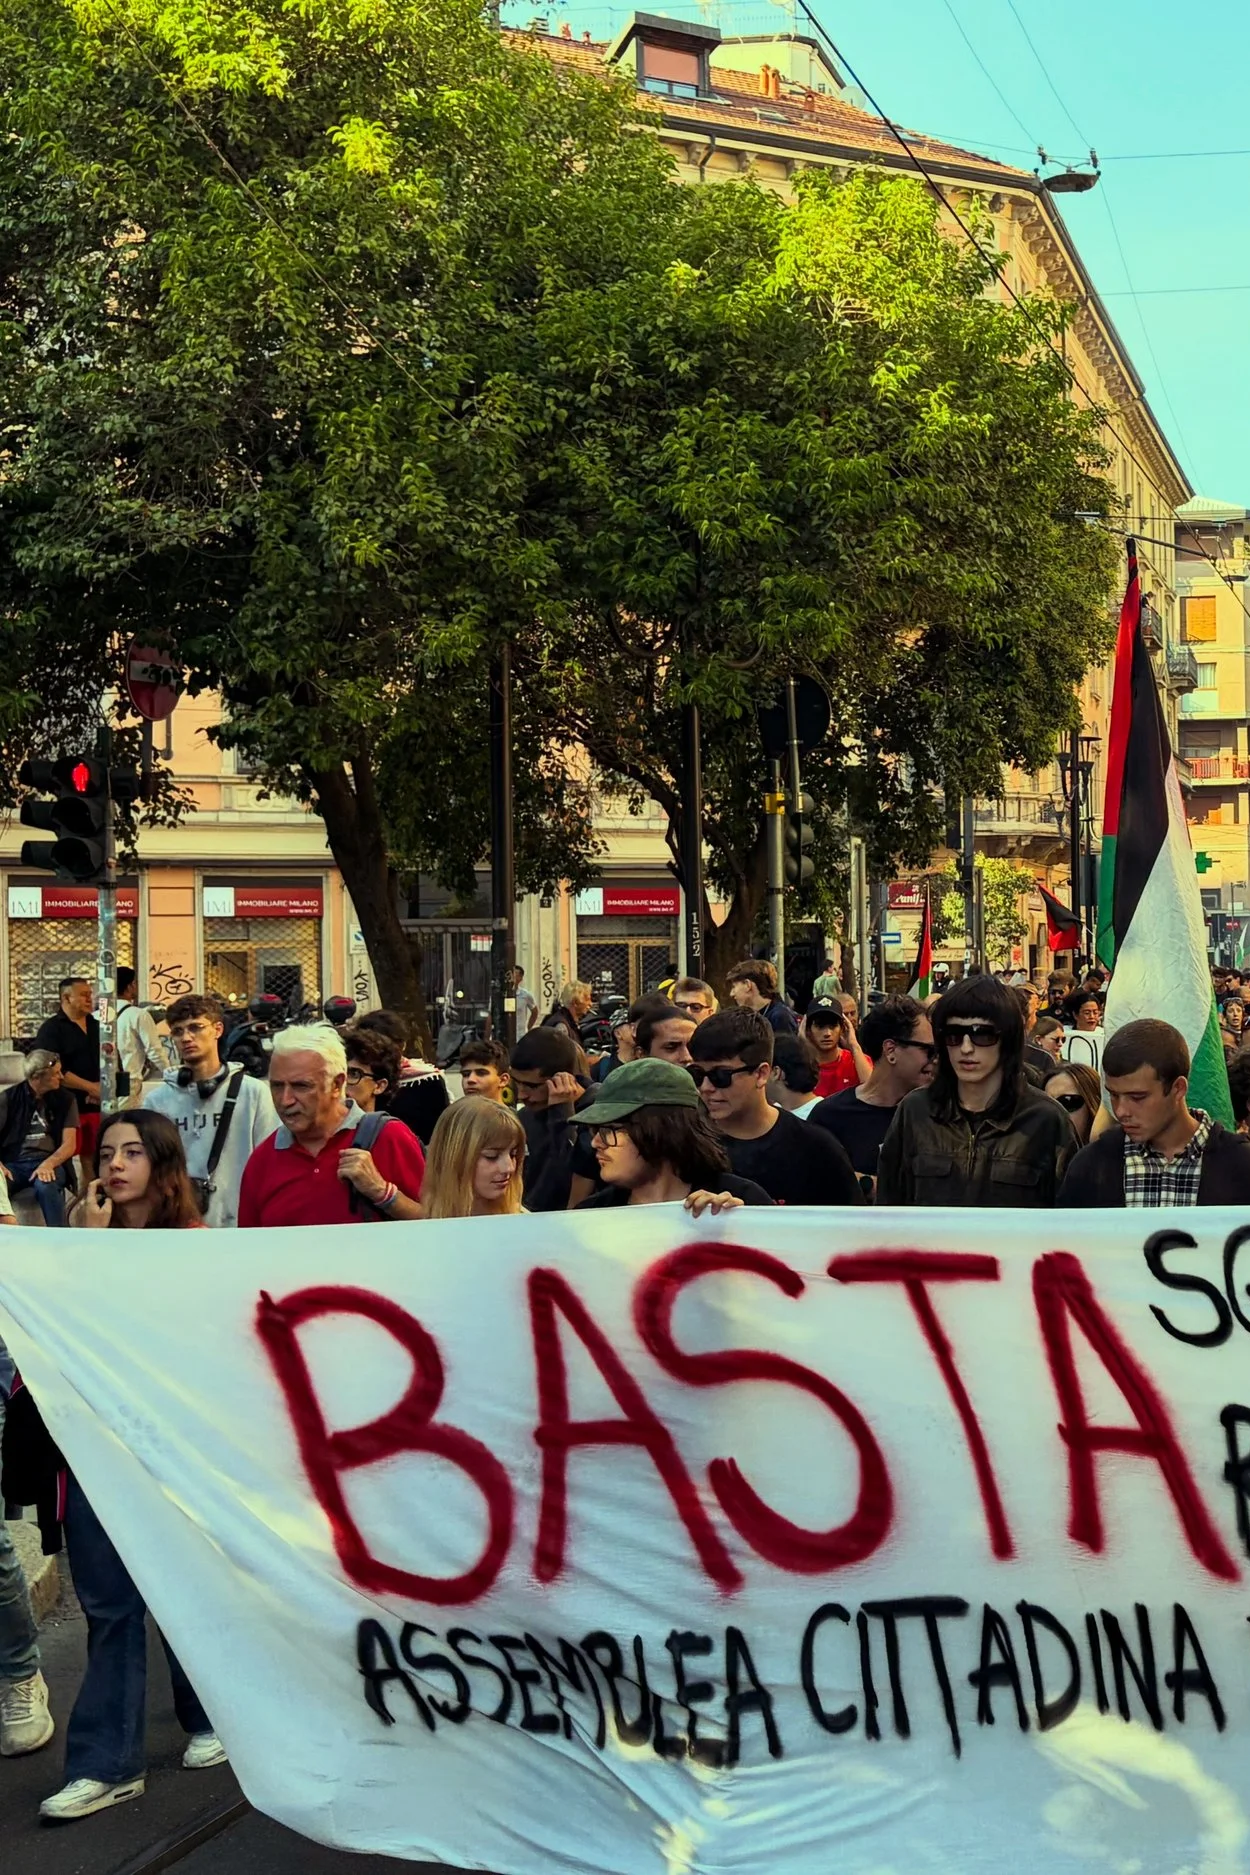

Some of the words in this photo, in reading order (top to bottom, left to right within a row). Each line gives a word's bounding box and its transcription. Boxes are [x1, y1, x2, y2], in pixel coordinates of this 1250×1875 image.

[11, 901, 39, 914] IMI
[206, 900, 232, 914] IMI
[579, 900, 601, 913] IMI
[255, 1241, 1242, 1605] BASTA
[356, 1617, 783, 1768] ASSEMBLEA
[801, 1595, 1227, 1760] CITTADINA
